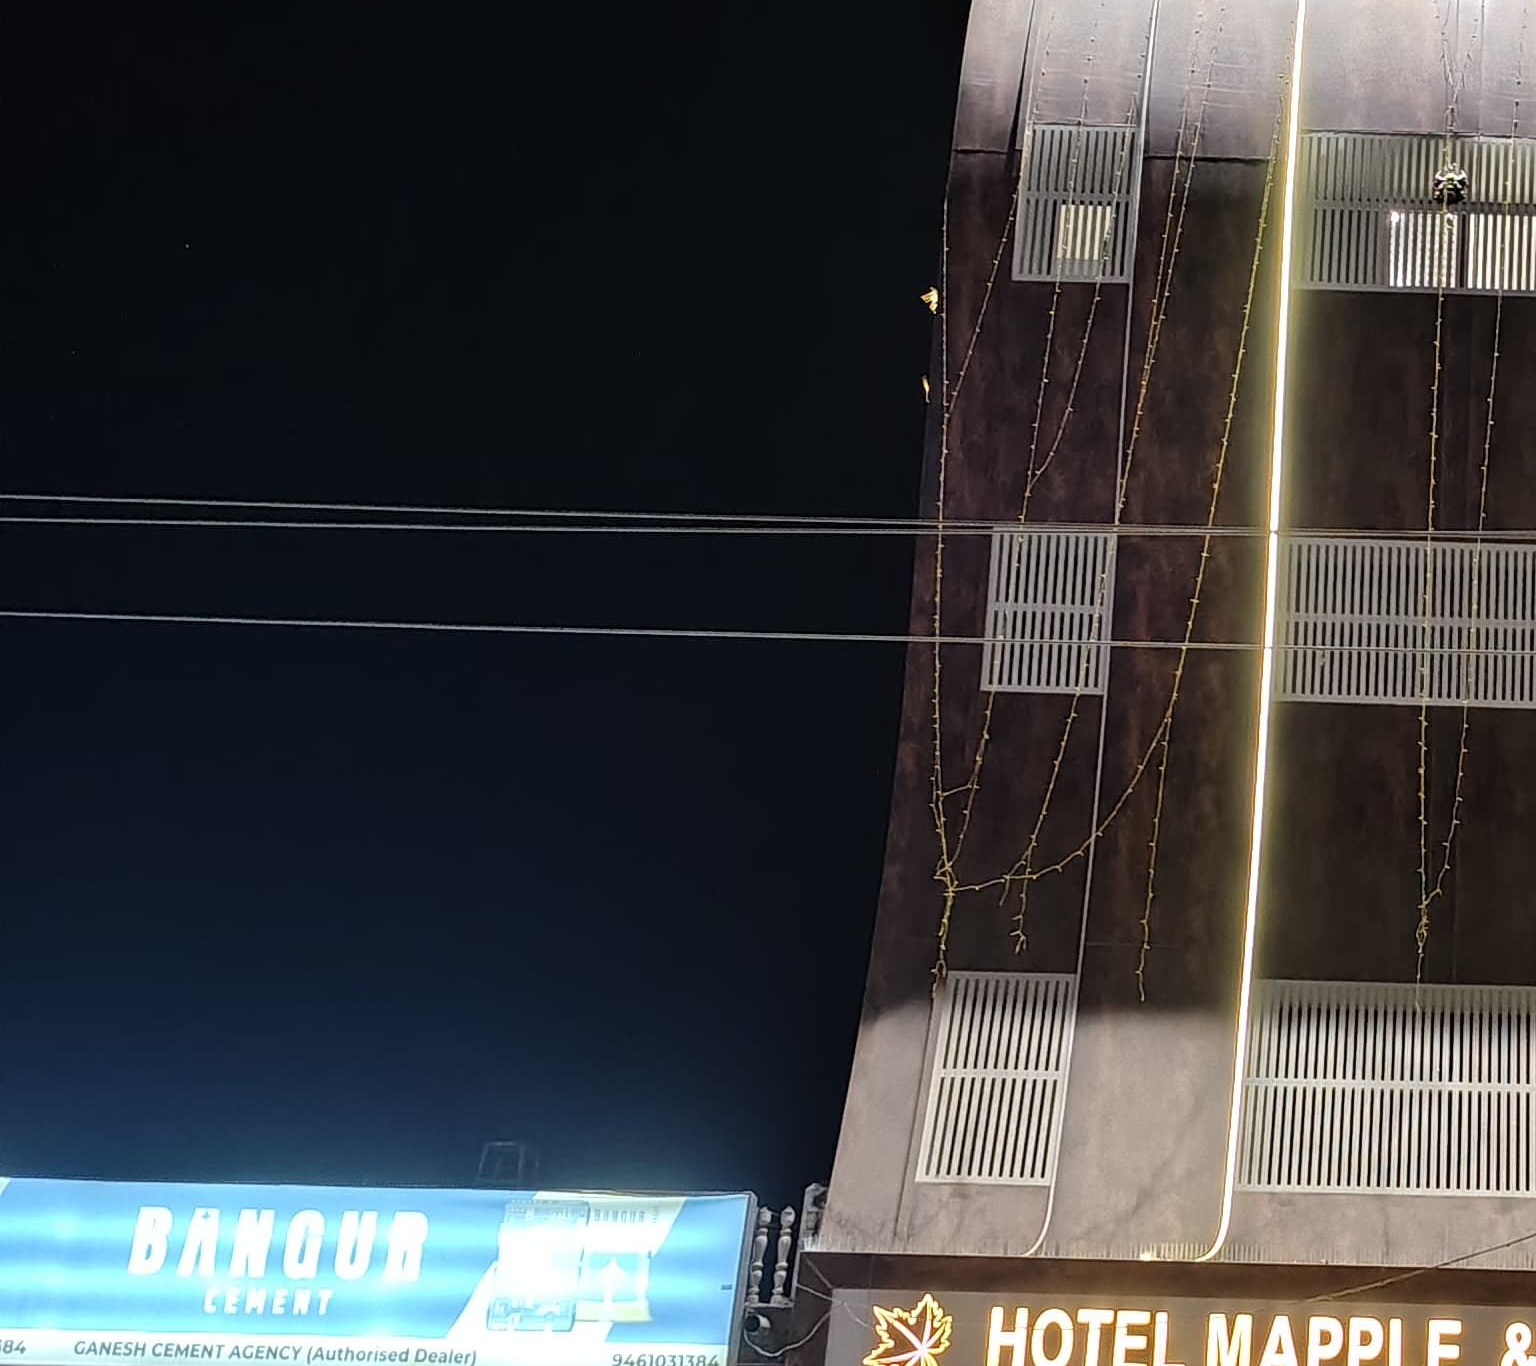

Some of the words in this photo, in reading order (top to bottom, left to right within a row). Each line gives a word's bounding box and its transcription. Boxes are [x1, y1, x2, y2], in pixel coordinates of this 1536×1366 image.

[127, 1206, 429, 1281] BANGUR
[203, 1288, 333, 1315] CEMENT
[74, 1340, 146, 1357] GANESH
[152, 1342, 225, 1359] CEMENT
[228, 1344, 301, 1361] AGENCY
[306, 1346, 409, 1364] (Authorised
